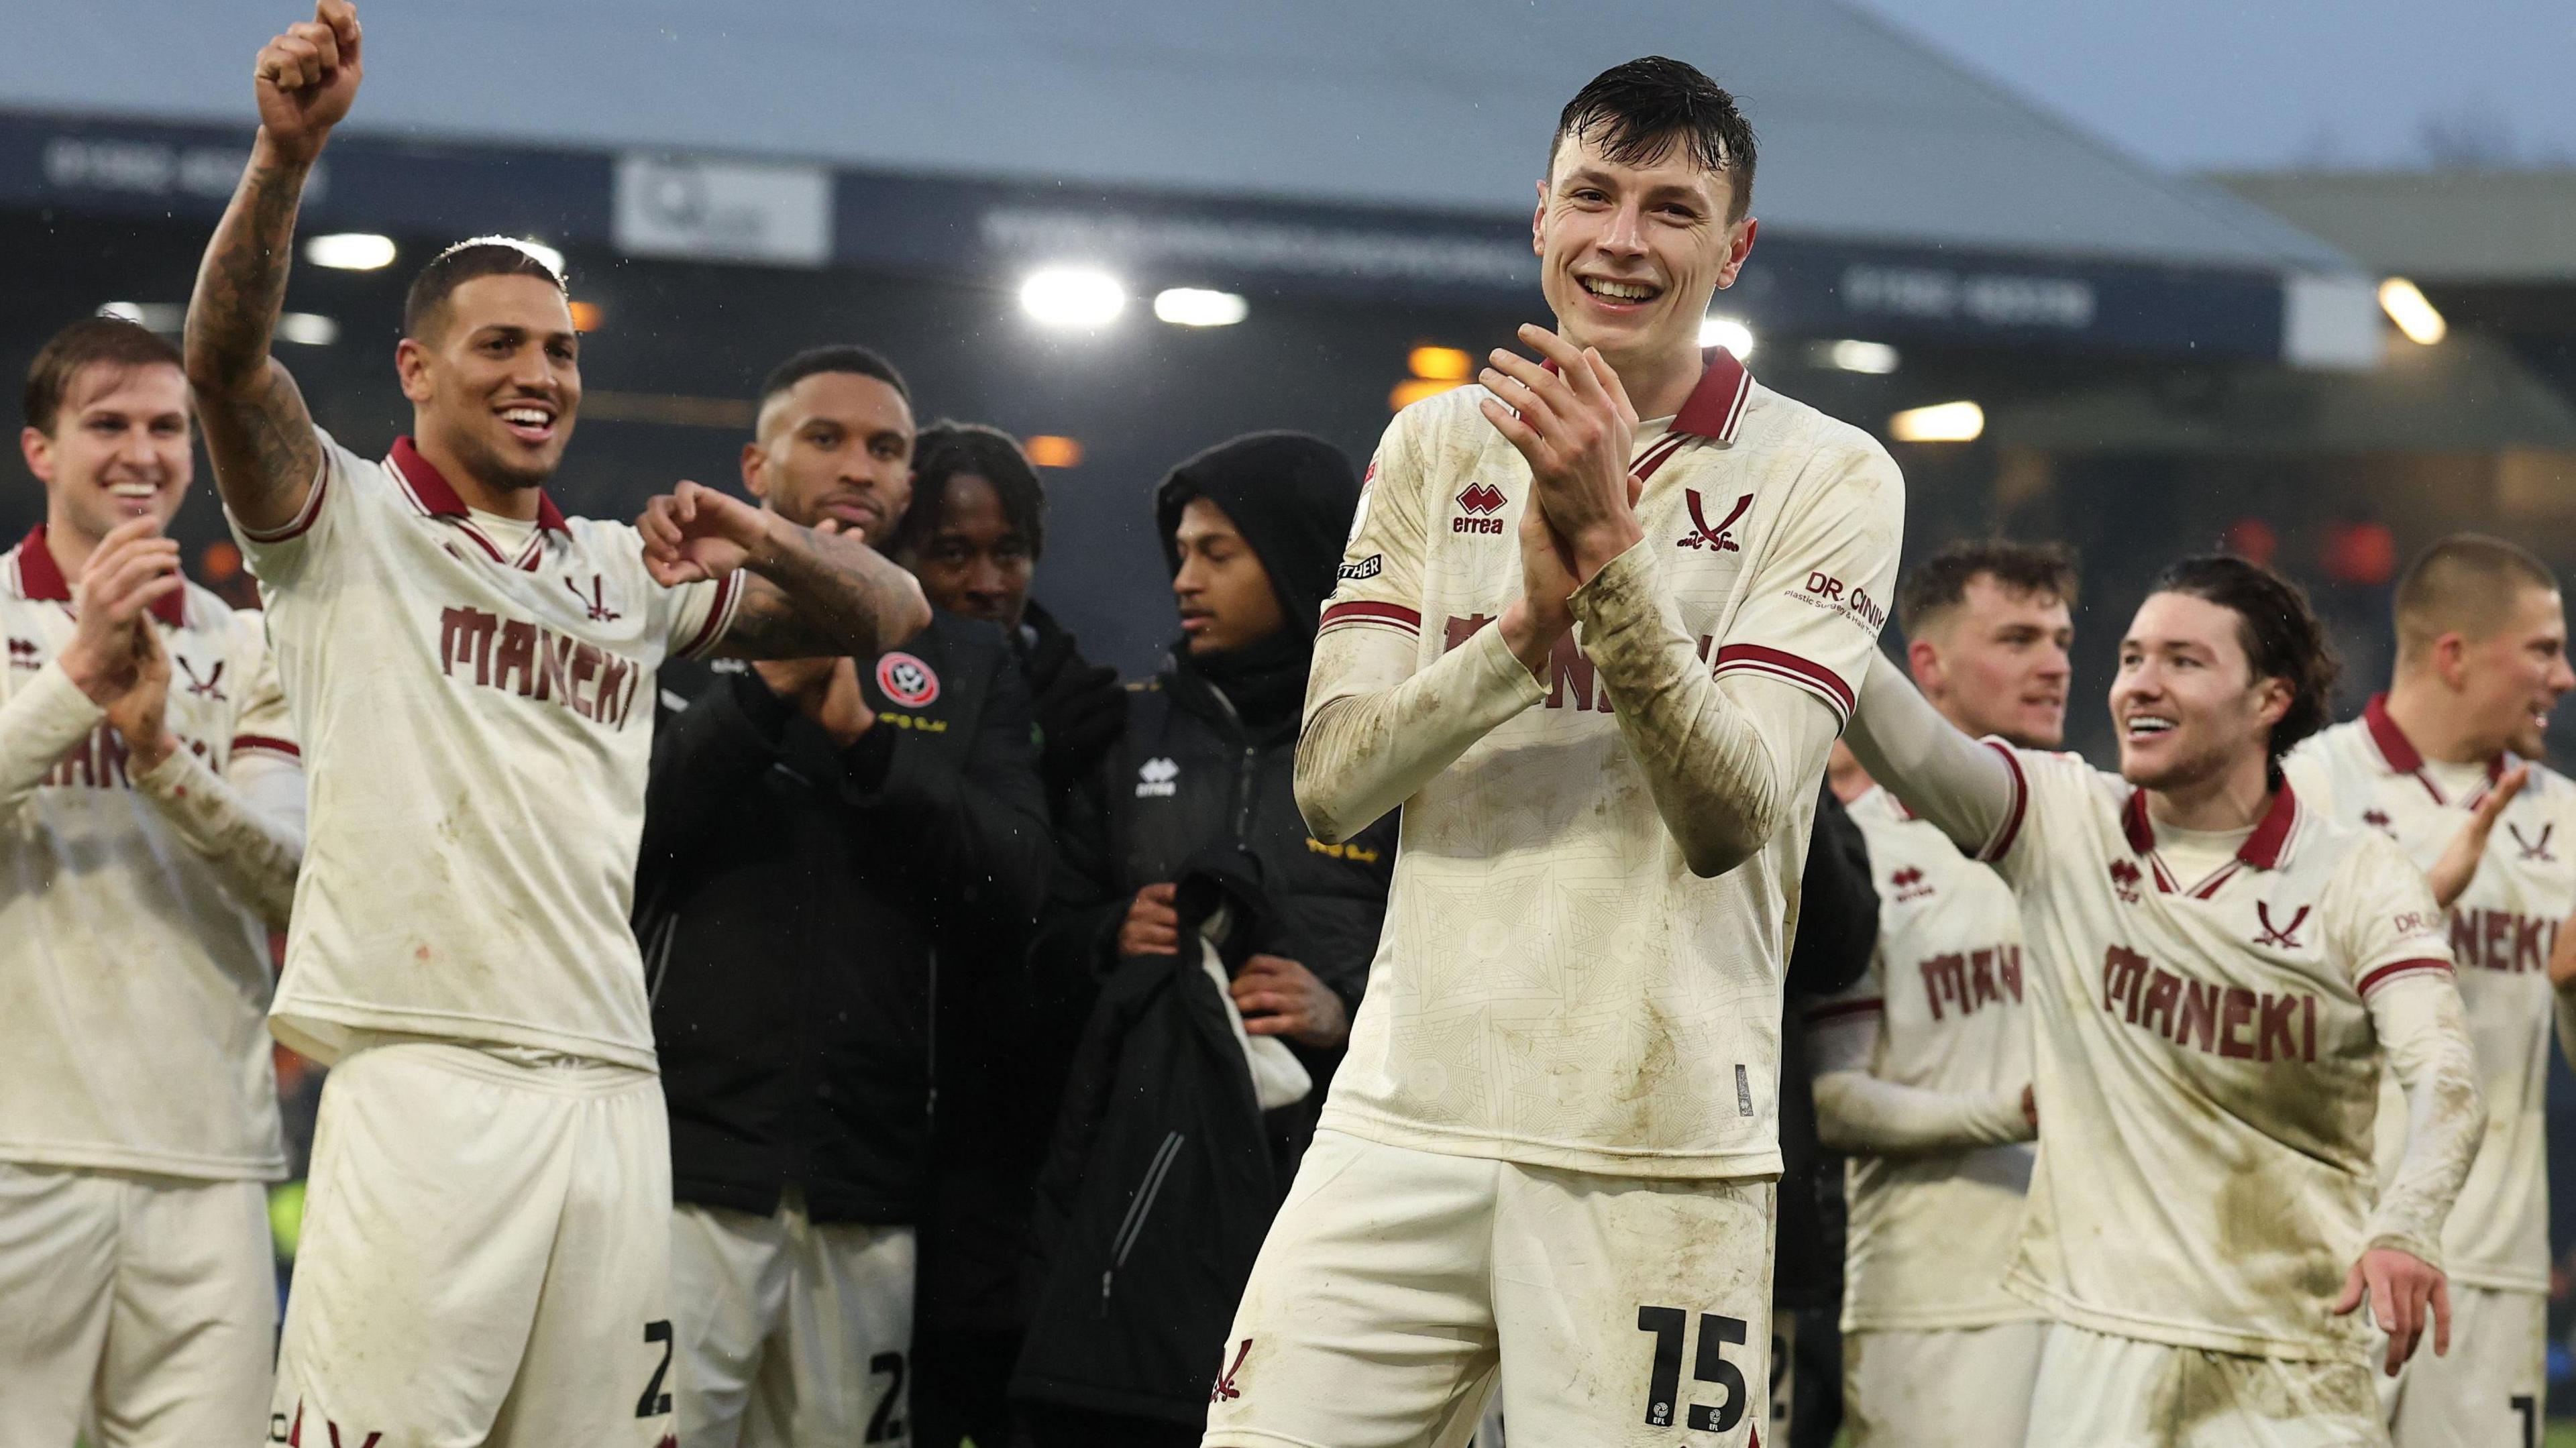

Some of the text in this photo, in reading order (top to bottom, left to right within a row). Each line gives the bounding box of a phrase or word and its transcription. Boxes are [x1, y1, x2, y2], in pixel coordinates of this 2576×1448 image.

[1453, 517, 1503, 535] errea
[1337, 557, 1379, 579] THER
[1806, 571, 1844, 602] DR.
[1784, 590, 1815, 605] Plastic
[1815, 600, 1846, 616] Surgery
[1845, 611, 1851, 619] &
[1851, 615, 1865, 630] Hair
[441, 606, 639, 732] MANEKI
[2451, 907, 2557, 972] NEKI
[1919, 944, 2023, 1021] MAN
[2103, 944, 2316, 1062] MANEKI
[1638, 1305, 1747, 1433] 15
[1653, 1416, 1666, 1425] EFL
[1709, 1423, 1719, 1431] EFL
